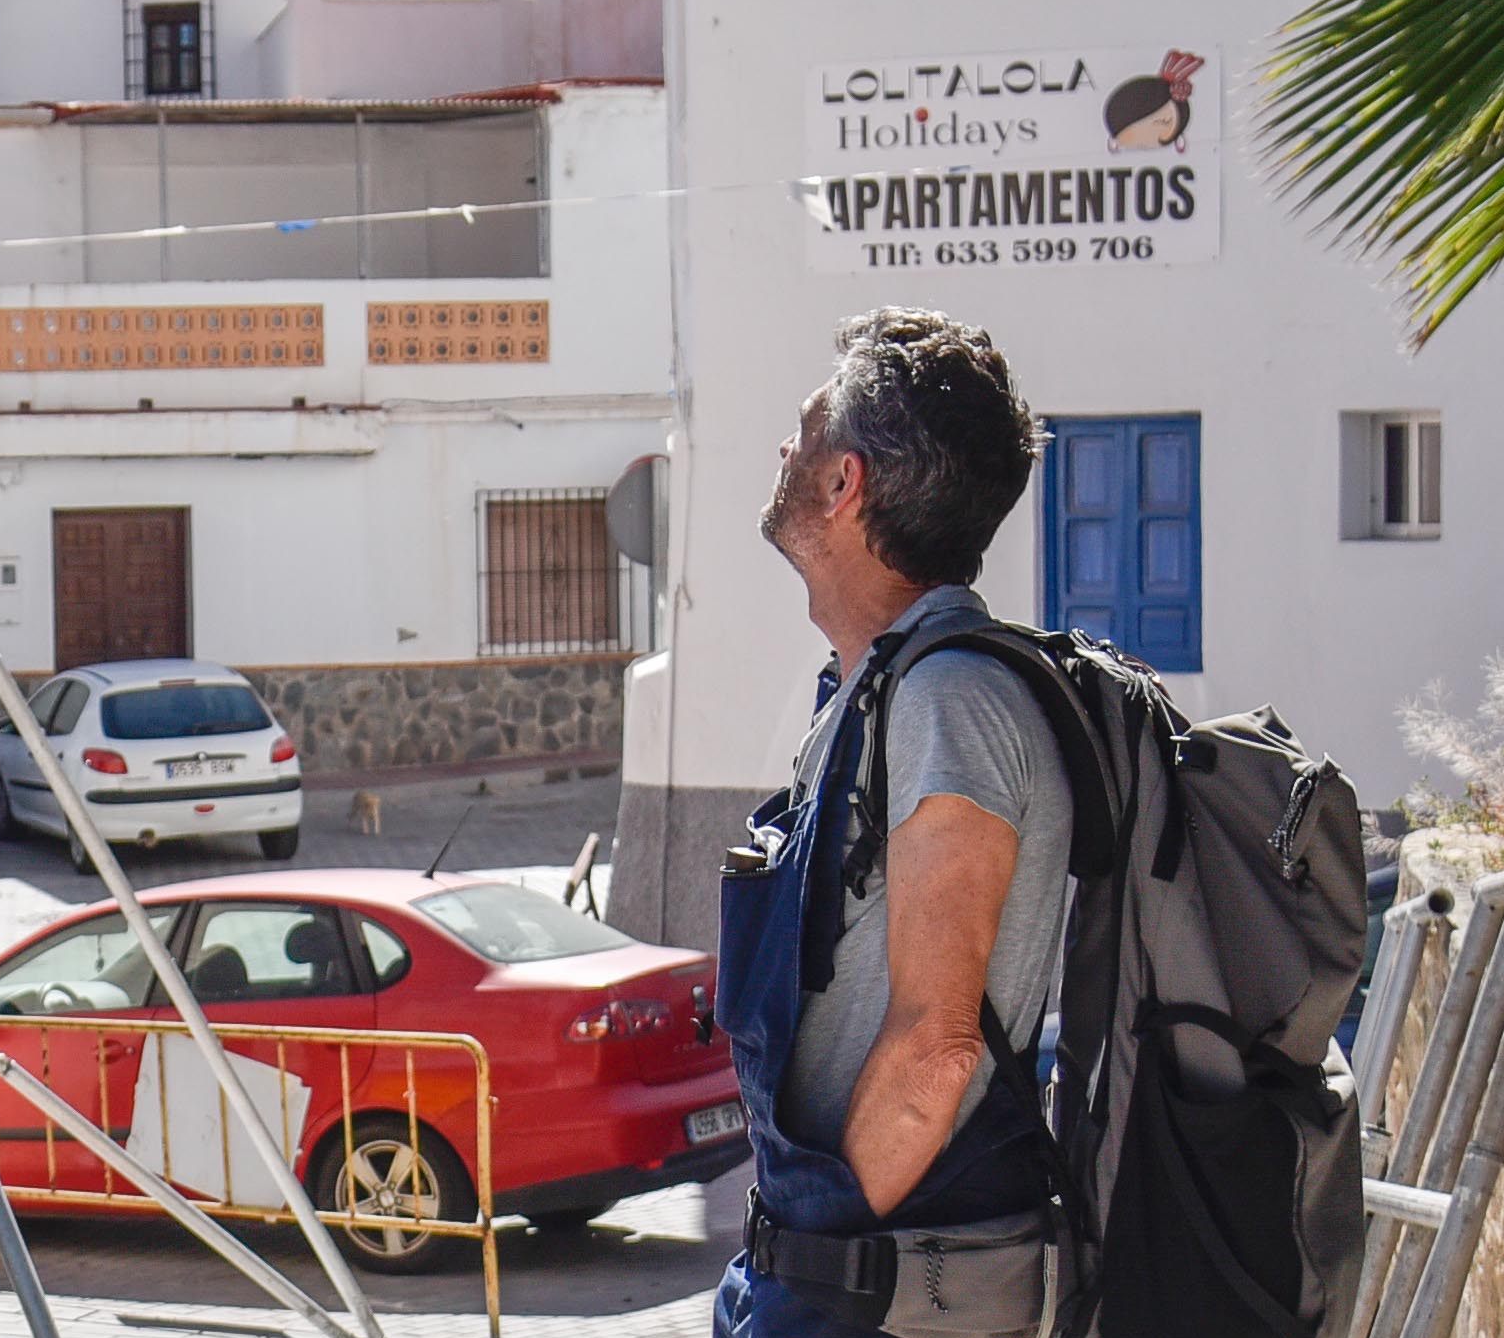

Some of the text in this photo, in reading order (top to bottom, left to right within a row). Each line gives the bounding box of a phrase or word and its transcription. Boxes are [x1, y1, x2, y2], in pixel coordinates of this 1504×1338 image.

[838, 108, 1040, 154] Holidays
[822, 166, 1197, 233] APARTAMENTOS
[934, 240, 1000, 266] 633
[1012, 238, 1077, 263] 599
[1089, 235, 1154, 261] 706
